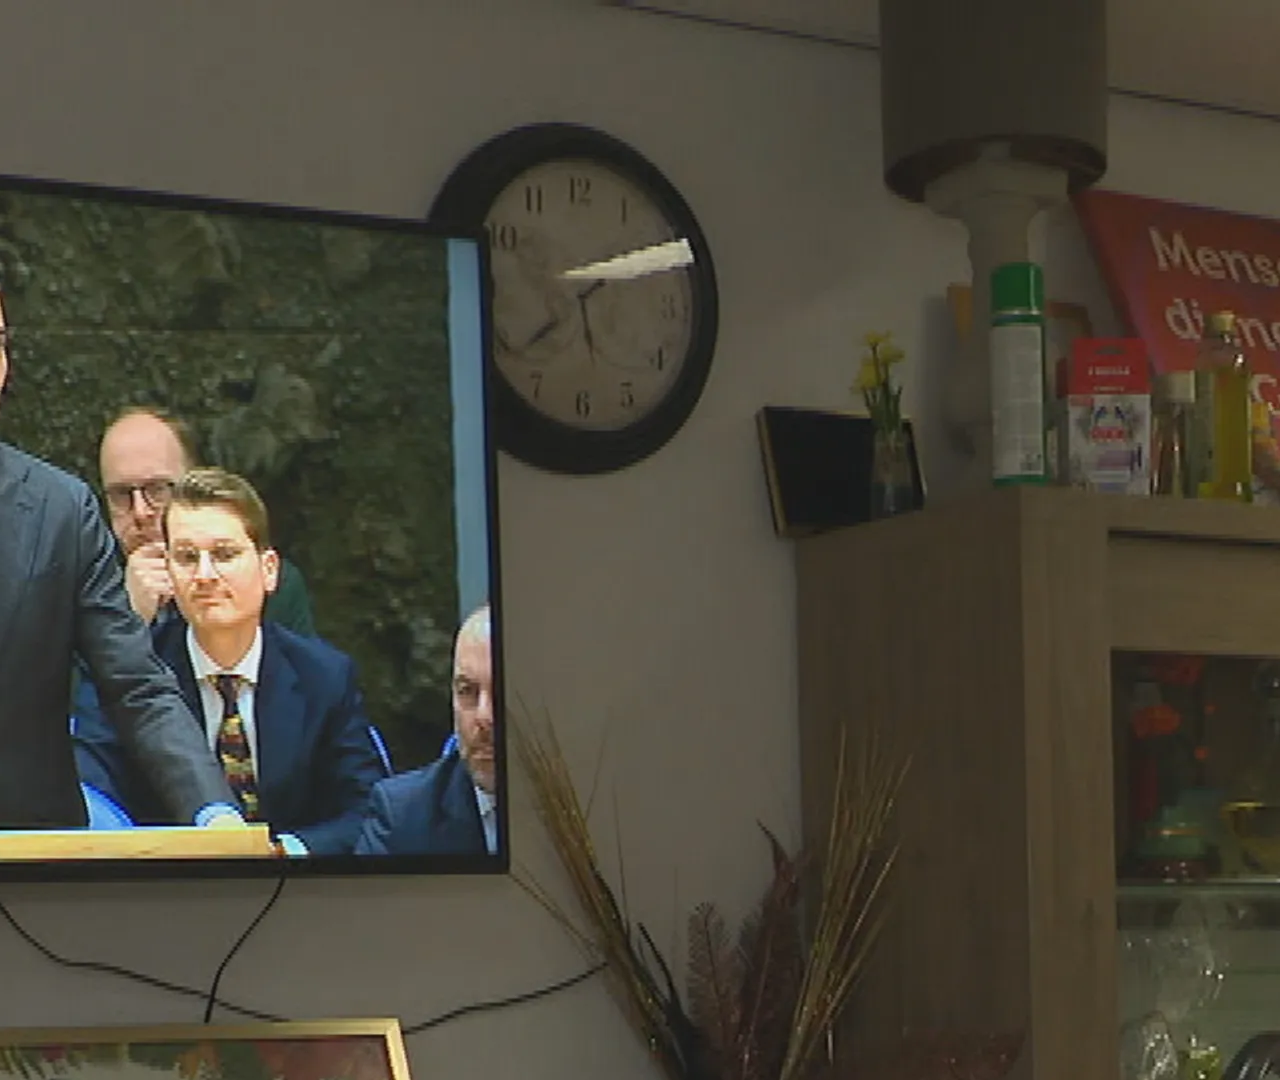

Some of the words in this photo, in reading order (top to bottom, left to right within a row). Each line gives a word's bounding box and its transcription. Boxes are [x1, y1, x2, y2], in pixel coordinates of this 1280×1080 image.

[525, 184, 544, 214] 11
[568, 177, 592, 207] 12
[620, 198, 628, 225] 1
[489, 222, 517, 251] 10
[661, 293, 677, 320] 3
[649, 346, 668, 371] 4
[530, 373, 545, 399] 7
[619, 381, 635, 408] 5
[575, 391, 591, 418] 6
